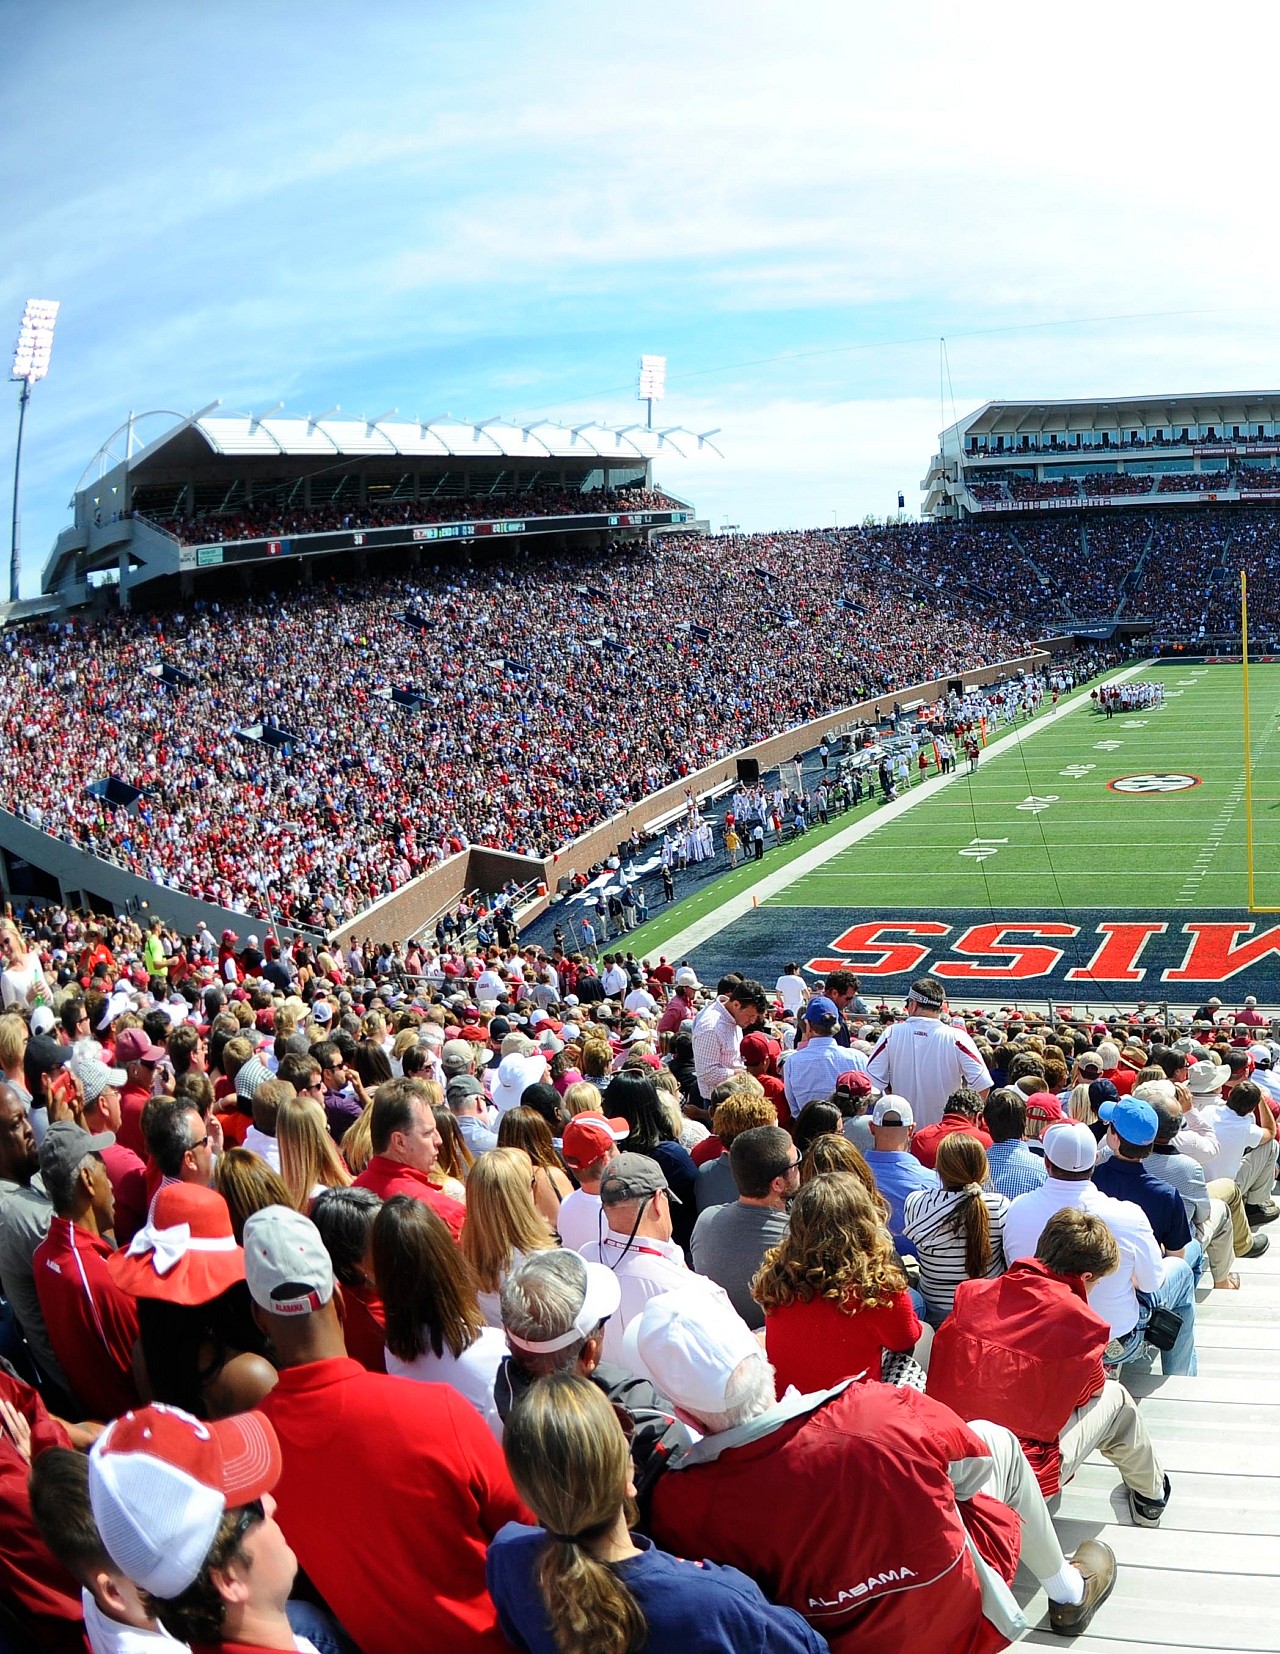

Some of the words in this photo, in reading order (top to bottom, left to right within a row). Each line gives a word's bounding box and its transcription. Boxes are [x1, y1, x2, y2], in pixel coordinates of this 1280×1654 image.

[1058, 763, 1097, 776] 30
[1015, 795, 1060, 811] 20
[958, 837, 1009, 856] 10
[275, 1303, 304, 1313] ALABAMA
[808, 1566, 916, 1608] ALABAMA
